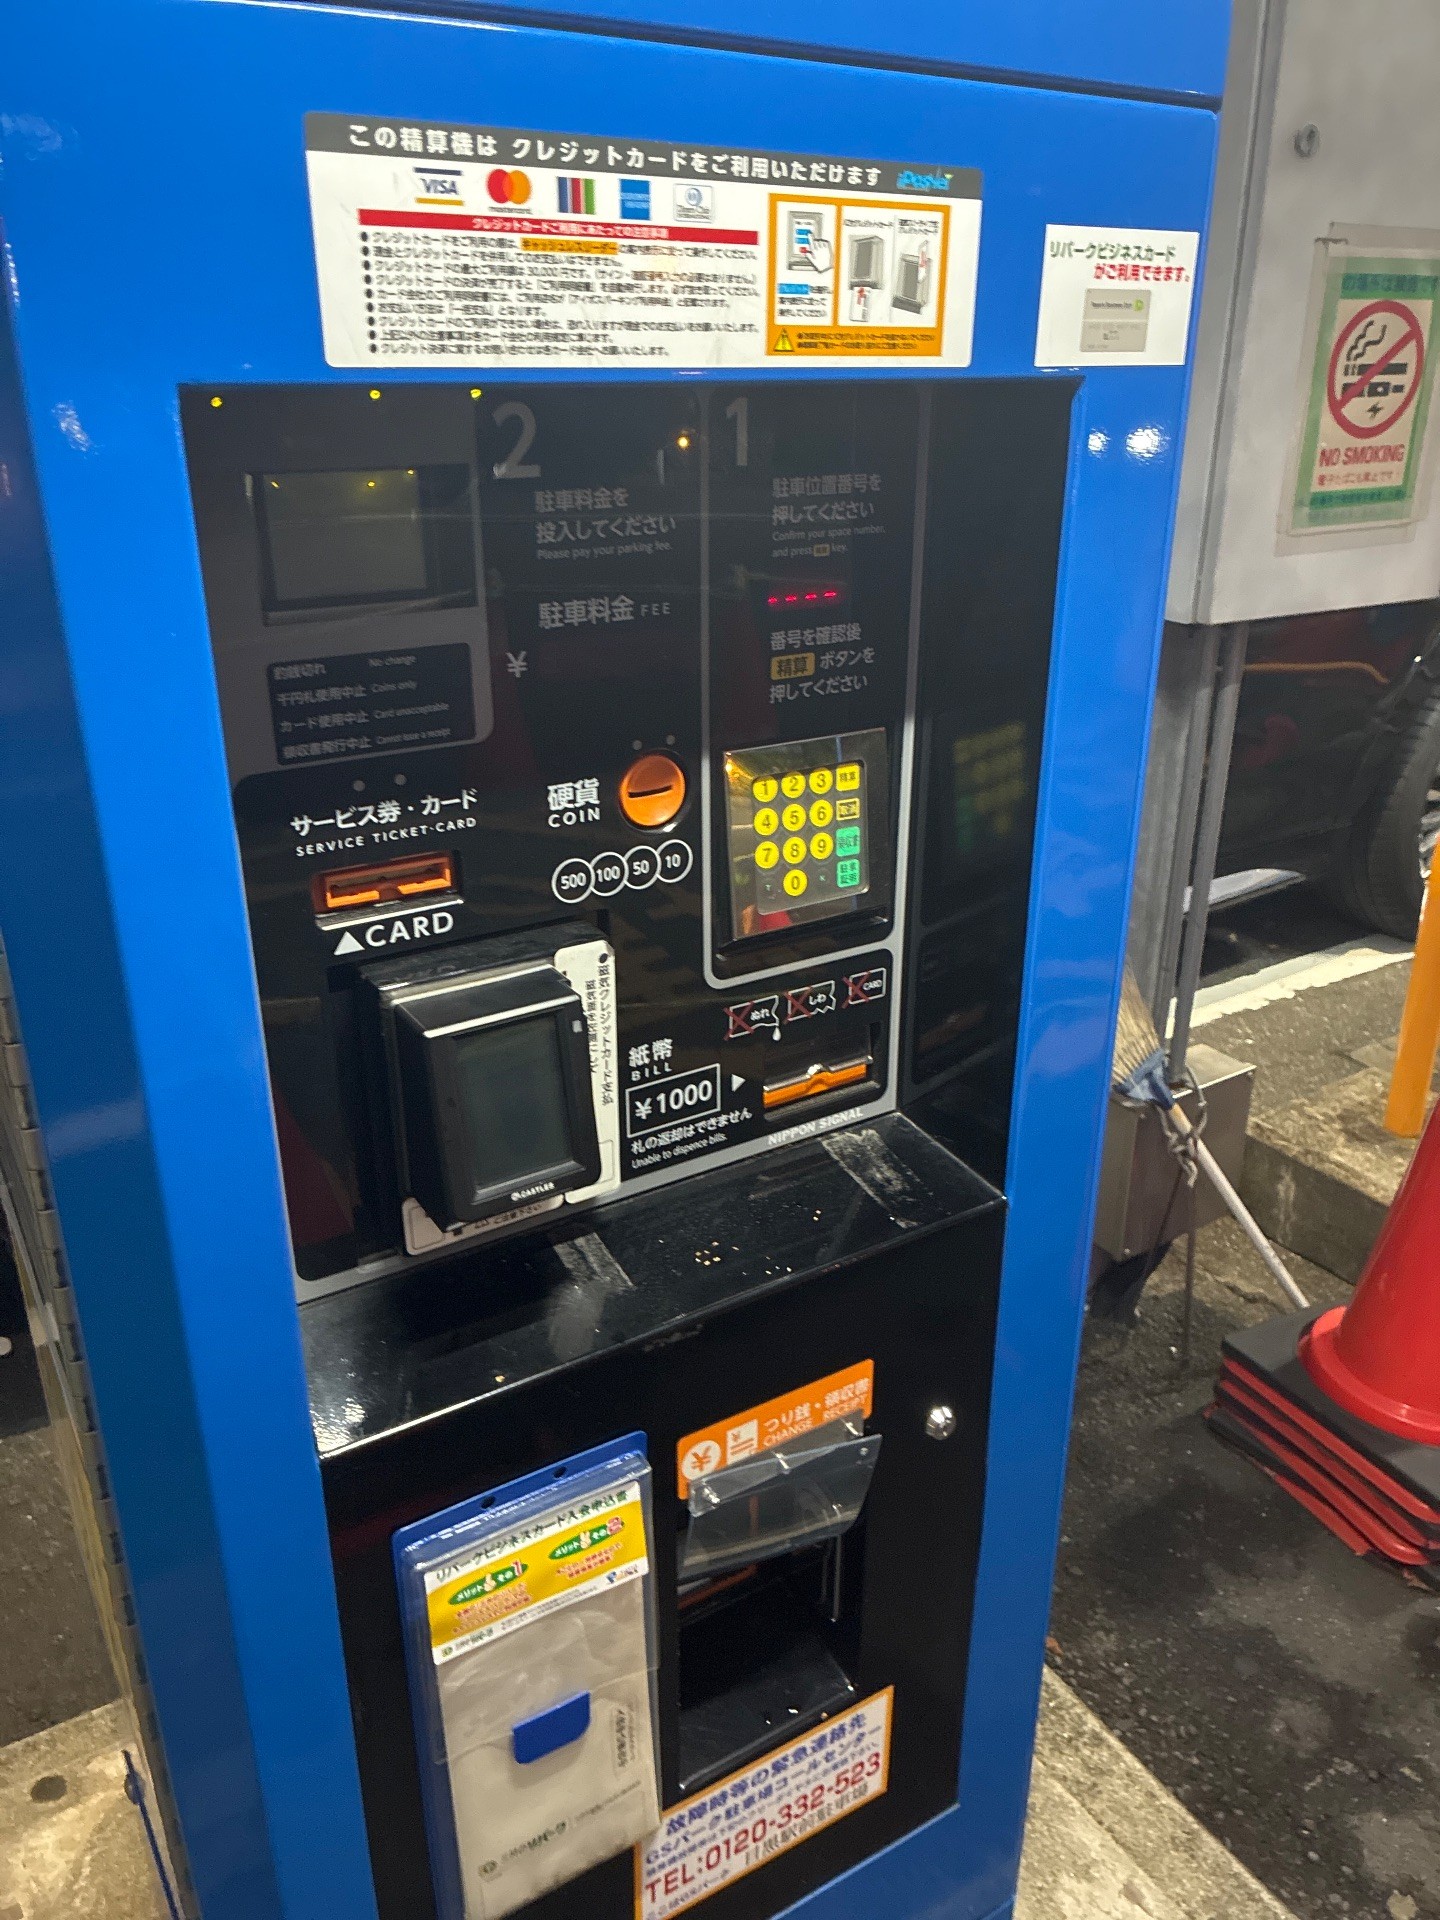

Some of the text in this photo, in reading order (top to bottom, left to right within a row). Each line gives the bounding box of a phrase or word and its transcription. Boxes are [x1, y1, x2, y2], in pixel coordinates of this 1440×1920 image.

[349, 124, 882, 187] この精算機は クレジットカードをご利用いただけます
[421, 177, 457, 196] VISA
[1050, 240, 1176, 263] リパークビジネスカード
[1093, 264, 1191, 284] がご利用できます。
[493, 402, 541, 480] 2
[726, 396, 748, 467] 1
[1319, 443, 1405, 467] NO SMOKING
[771, 473, 882, 499] 駐車位置番号を
[535, 487, 629, 514] 駐車料金を
[772, 502, 875, 527] 押してください
[536, 515, 676, 546] 投入してください
[772, 530, 806, 543] Confirm
[808, 530, 827, 542] your
[828, 528, 852, 541] space
[572, 548, 592, 561] pay
[593, 545, 615, 558] your
[617, 542, 654, 556] parking
[772, 546, 788, 558] and
[790, 546, 813, 559] press
[538, 594, 671, 630] 駐車料金 FEE
[771, 623, 862, 651] 番号を確認後
[776, 648, 875, 678] 精算 ボタンを
[769, 675, 868, 705] 押してください
[547, 777, 600, 811] 硬貨
[789, 777, 798, 792] 2
[816, 773, 826, 788] 3
[290, 788, 479, 837] サービス券・カード
[548, 807, 600, 828] COIN
[761, 814, 771, 828] 4
[790, 810, 799, 825] 5
[817, 806, 827, 821] 6
[295, 836, 365, 857] SERVICE
[762, 847, 772, 862] 7
[790, 843, 799, 858] 8
[817, 839, 827, 853] 9
[560, 853, 681, 890] 500 100 50 10
[791, 875, 800, 890] 0
[365, 911, 454, 947] CARD
[862, 979, 883, 991] CARD
[628, 1037, 673, 1067] 紙幣
[631, 1062, 672, 1081] BILL
[635, 1079, 713, 1120] ¥1000
[631, 1107, 752, 1155] 札の返却はできません
[767, 1107, 864, 1146] NIPPON SIGNAL
[631, 1152, 661, 1169] Unable
[662, 1150, 672, 1160] to
[763, 1393, 868, 1447] CHANGE RECEIPT
[554, 1541, 580, 1558] メリット
[456, 1584, 484, 1603] メリット
[667, 1713, 866, 1836] 故障時等の緊急連絡先
[646, 1726, 881, 1865] GSパーク駐車場コールセンター
